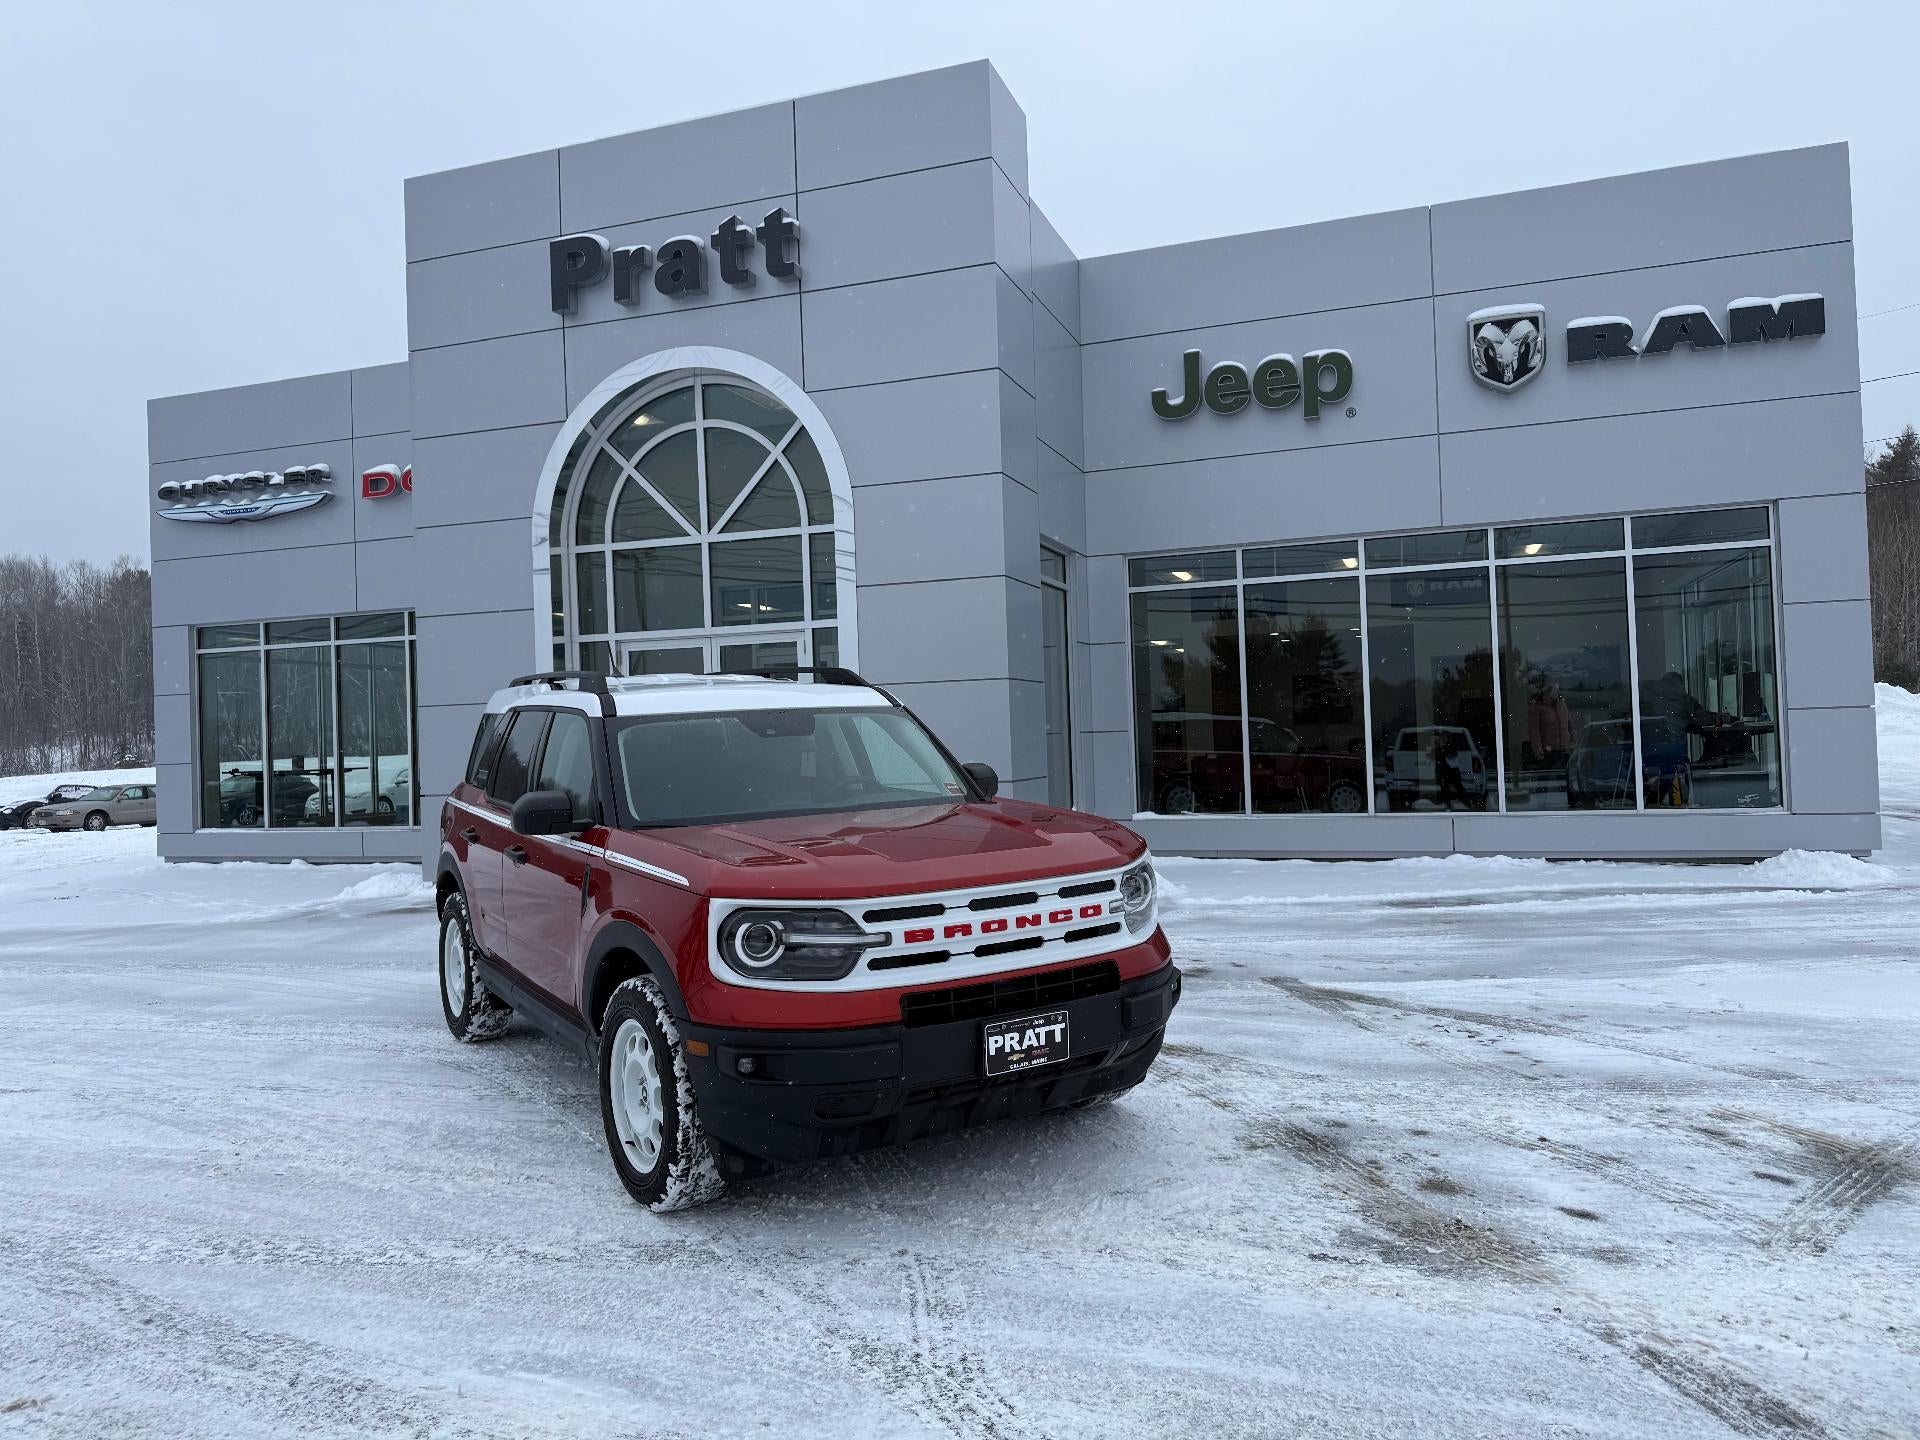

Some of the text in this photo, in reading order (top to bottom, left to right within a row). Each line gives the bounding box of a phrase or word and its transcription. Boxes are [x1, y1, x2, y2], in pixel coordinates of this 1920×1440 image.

[550, 207, 802, 315] Pratt
[1567, 294, 1825, 366] RAM
[1151, 349, 1353, 421] Jeep
[904, 904, 1102, 944] BRONCO
[988, 1022, 1066, 1056] PRATT
